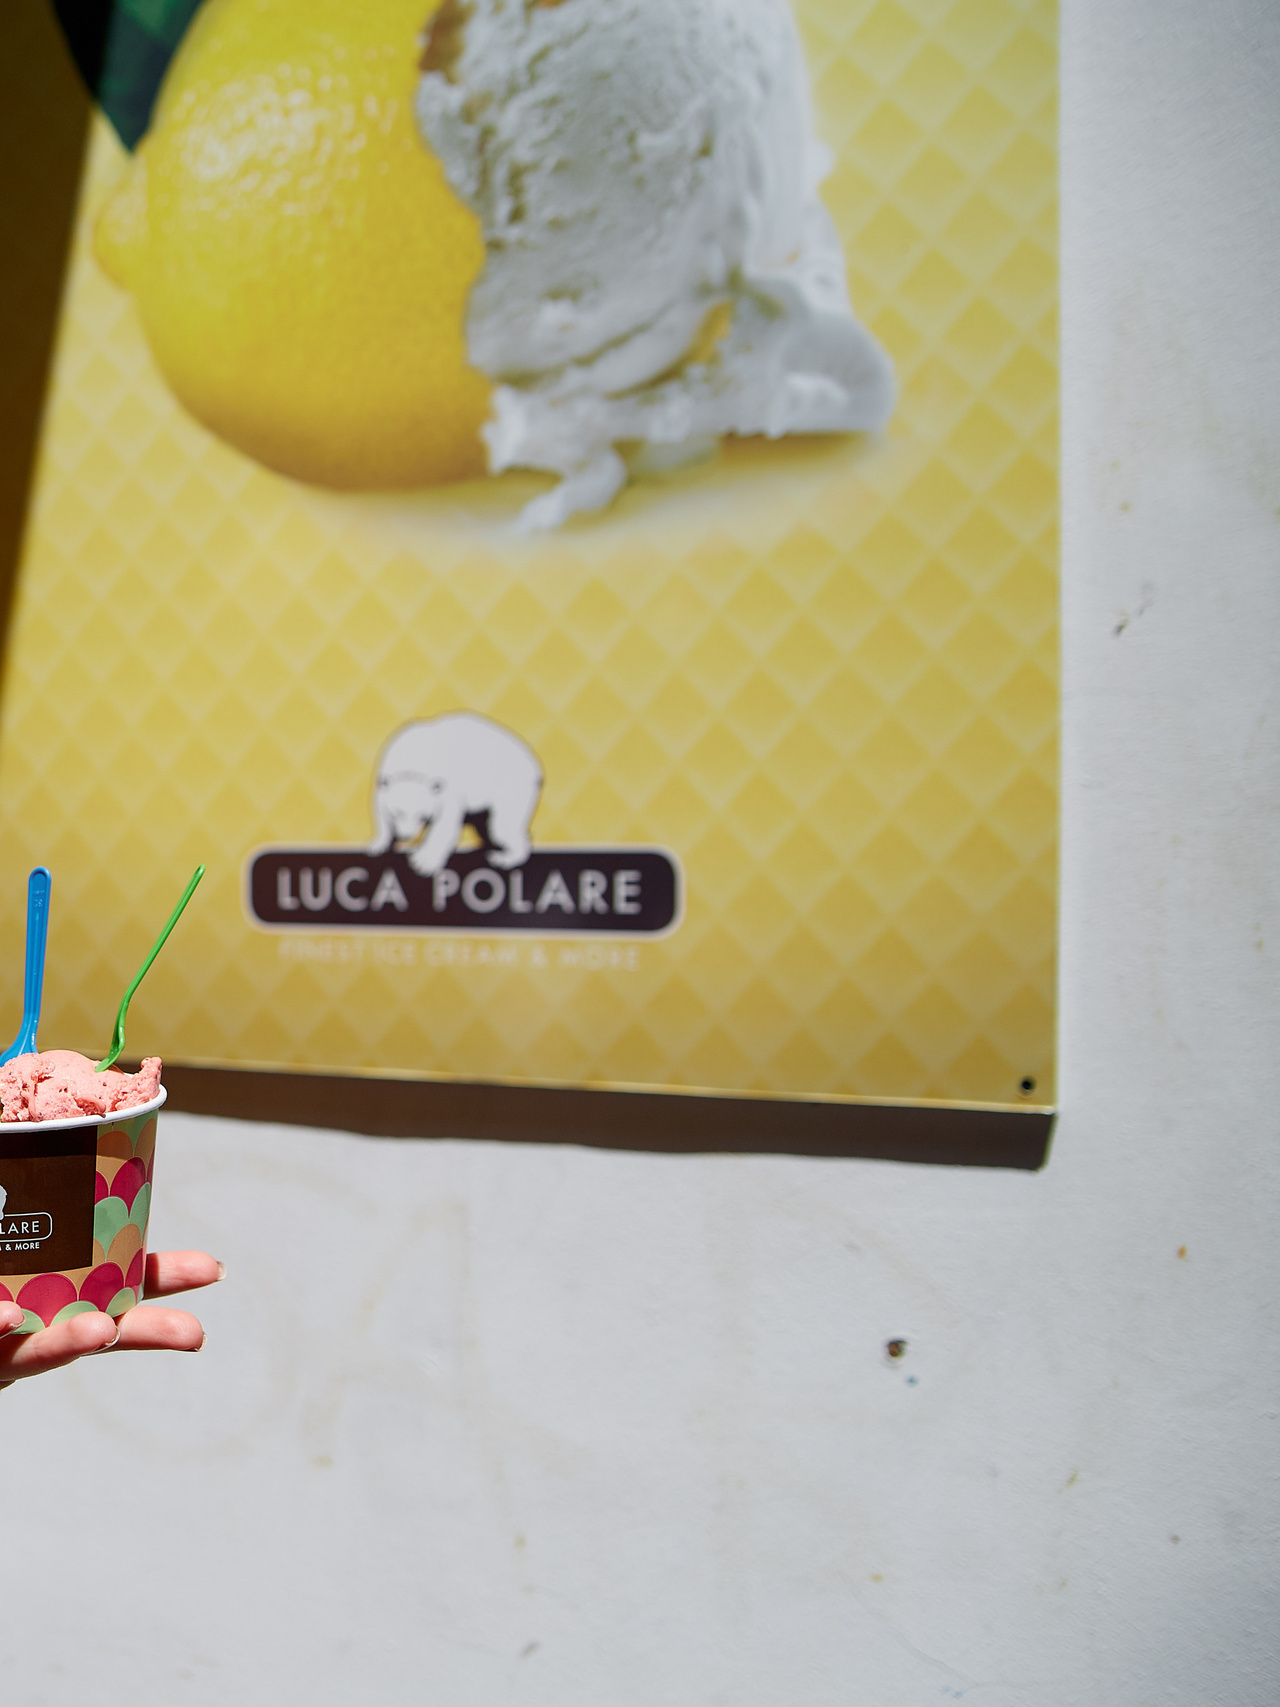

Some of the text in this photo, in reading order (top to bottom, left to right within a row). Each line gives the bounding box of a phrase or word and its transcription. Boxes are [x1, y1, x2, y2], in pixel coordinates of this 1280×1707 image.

[276, 866, 643, 916] LUCA POLARE
[278, 937, 641, 973] FINEST ICE CREAM & MORE
[4, 1243, 12, 1251] &
[14, 1241, 40, 1251] MORE
